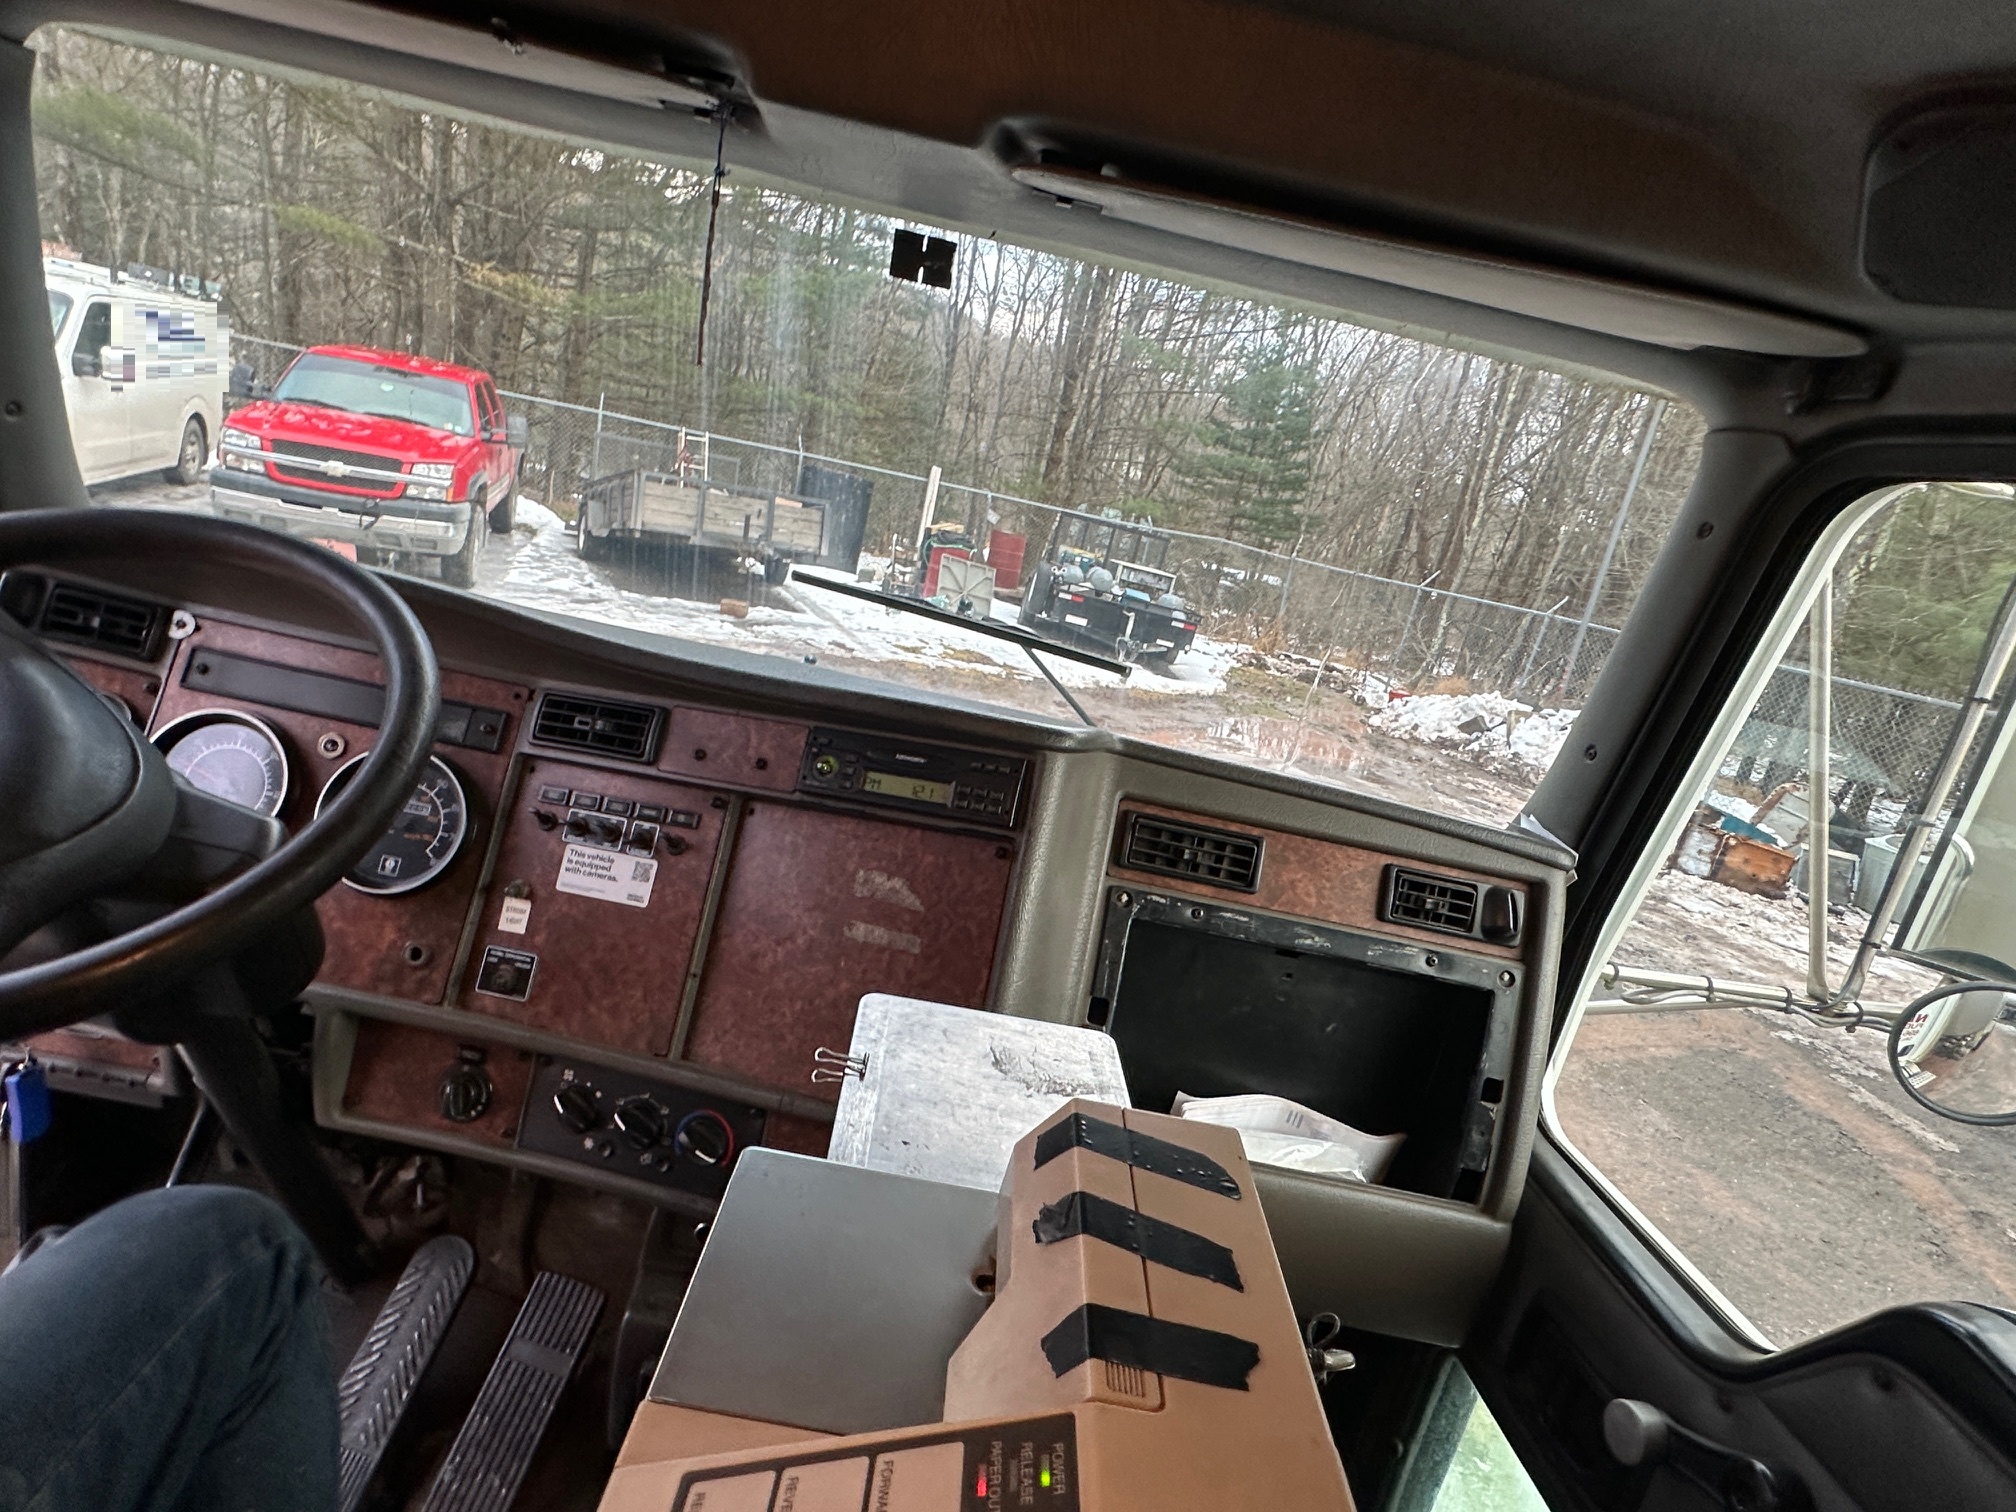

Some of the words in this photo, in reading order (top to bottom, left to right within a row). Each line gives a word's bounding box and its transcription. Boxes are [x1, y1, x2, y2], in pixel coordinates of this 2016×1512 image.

[569, 848, 586, 859] This
[587, 853, 615, 864] vehicle
[574, 859, 612, 873] equipped
[564, 865, 582, 875] with
[582, 870, 618, 882] cameras.
[988, 1440, 1003, 1485] PAPER
[1019, 1441, 1034, 1506] RELEASE
[1051, 1442, 1067, 1496] POWER
